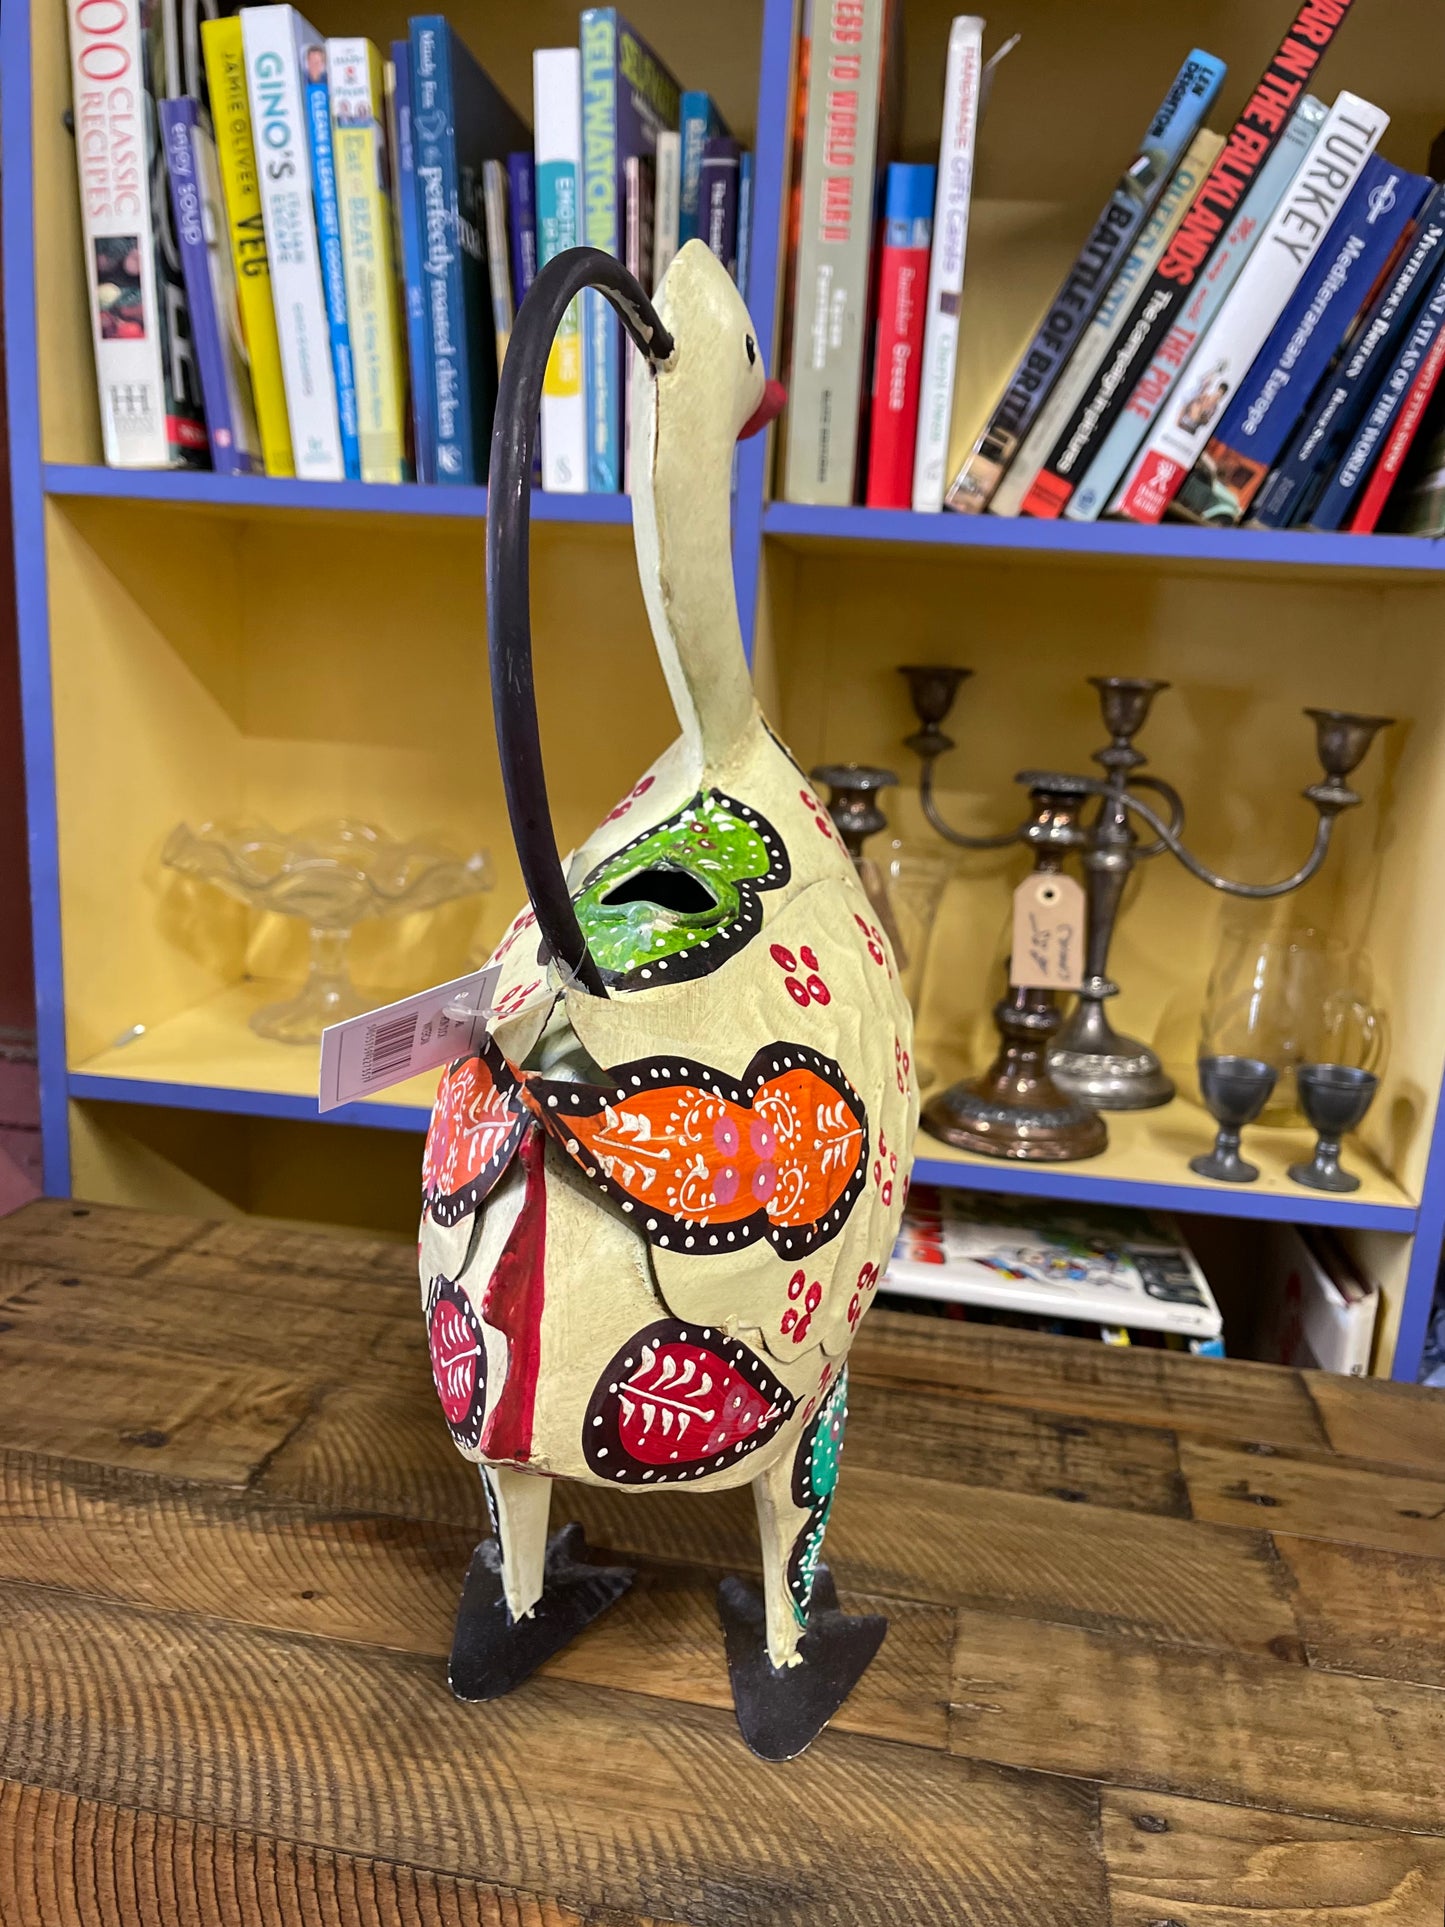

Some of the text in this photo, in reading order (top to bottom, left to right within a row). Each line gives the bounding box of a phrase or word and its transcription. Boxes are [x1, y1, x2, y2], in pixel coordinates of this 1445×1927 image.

[831, 0, 865, 45] ESS
[1272, 35, 1321, 81] IN
[828, 54, 862, 81] TO
[1147, 59, 1201, 139] DEIGHTON
[1189, 65, 1216, 98] LEN
[1241, 65, 1303, 133] THE
[80, 91, 112, 219] RECIPES
[107, 86, 140, 217] CLASSIC
[254, 51, 296, 181] GINO'S
[582, 20, 617, 258] SELFWATCHIN
[823, 89, 860, 169] WORLD
[171, 122, 202, 246] enjoy soup
[221, 52, 270, 278] JAMIE OLIVER VEG
[943, 46, 978, 275] HANDMADE Gift Cards
[1273, 114, 1377, 264] TURKEY
[418, 166, 455, 280] perfectly
[820, 175, 854, 225] WAR
[1138, 172, 1196, 252] QUEEN
[1150, 121, 1274, 289] FALKLANDS
[1058, 202, 1136, 312] BATTLE
[1377, 221, 1444, 322] MYSTERIOUS
[430, 279, 457, 357] roasted
[1037, 312, 1075, 354] OF
[1139, 284, 1174, 325] The
[1273, 233, 1368, 372] Mediterranean
[1396, 311, 1440, 372] ATLAS
[888, 341, 912, 412] Greece
[1093, 315, 1155, 399] campaign
[1155, 321, 1197, 369] THE
[1342, 316, 1390, 382] BRITAIN
[1385, 365, 1411, 396] OF
[435, 357, 459, 439] chicken
[1124, 363, 1172, 422] POLE
[1235, 366, 1290, 438] Europe
[1367, 390, 1399, 429] THE
[1049, 405, 1104, 476] pictures
[1335, 424, 1381, 489] WORLD
